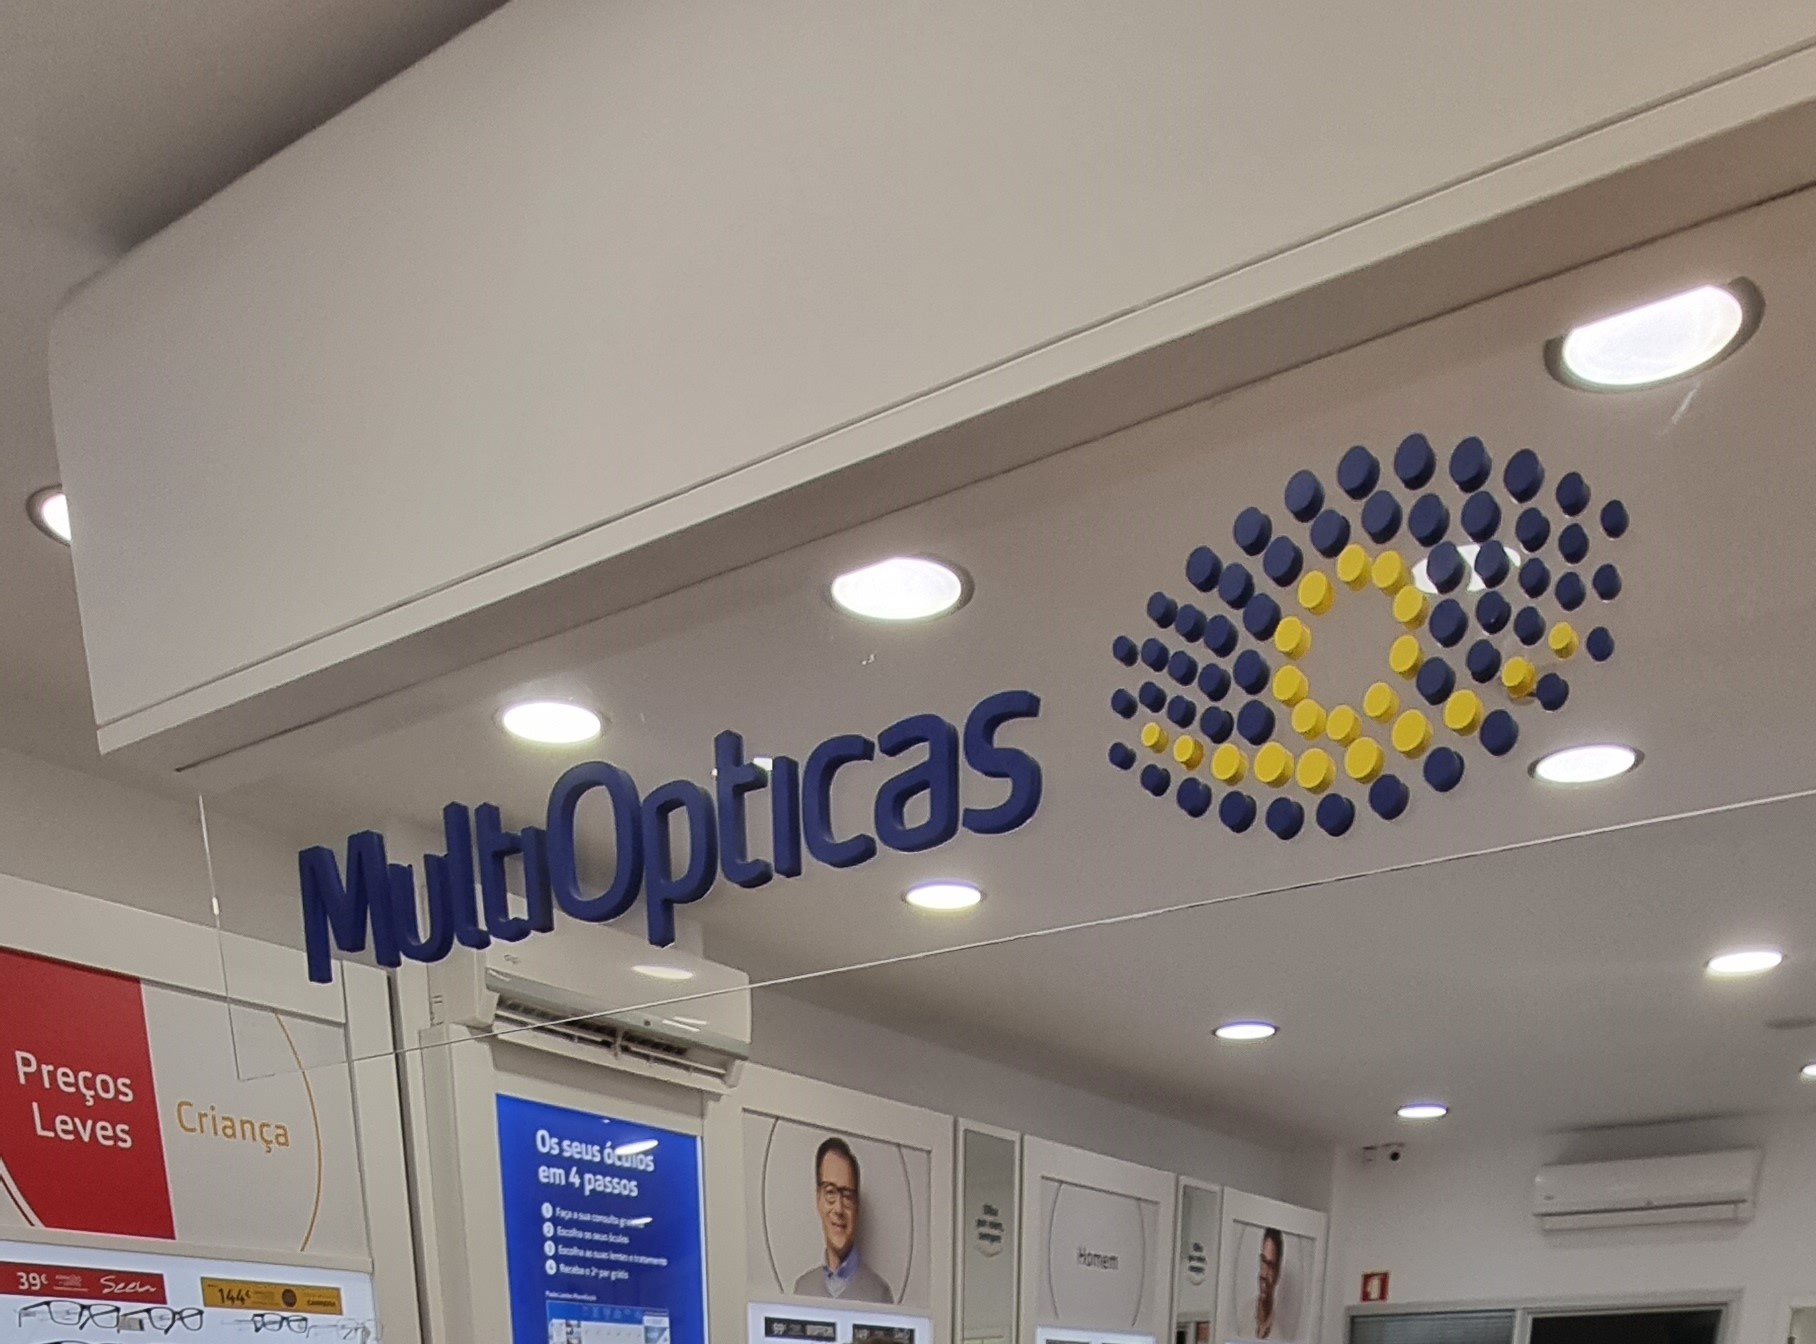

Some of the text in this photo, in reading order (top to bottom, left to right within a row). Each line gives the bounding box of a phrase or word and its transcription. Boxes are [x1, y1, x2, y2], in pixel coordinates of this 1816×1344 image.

[298, 689, 1044, 984] MultiOpticas
[15, 1051, 134, 1106] Preços
[32, 1102, 133, 1148] Leves
[176, 1100, 290, 1153] Criança
[536, 1129, 560, 1155] Os
[562, 1140, 600, 1162] seus
[538, 1165, 639, 1197] em 4 passos
[1077, 1246, 1119, 1271] Homem
[16, 1272, 49, 1291] 39€
